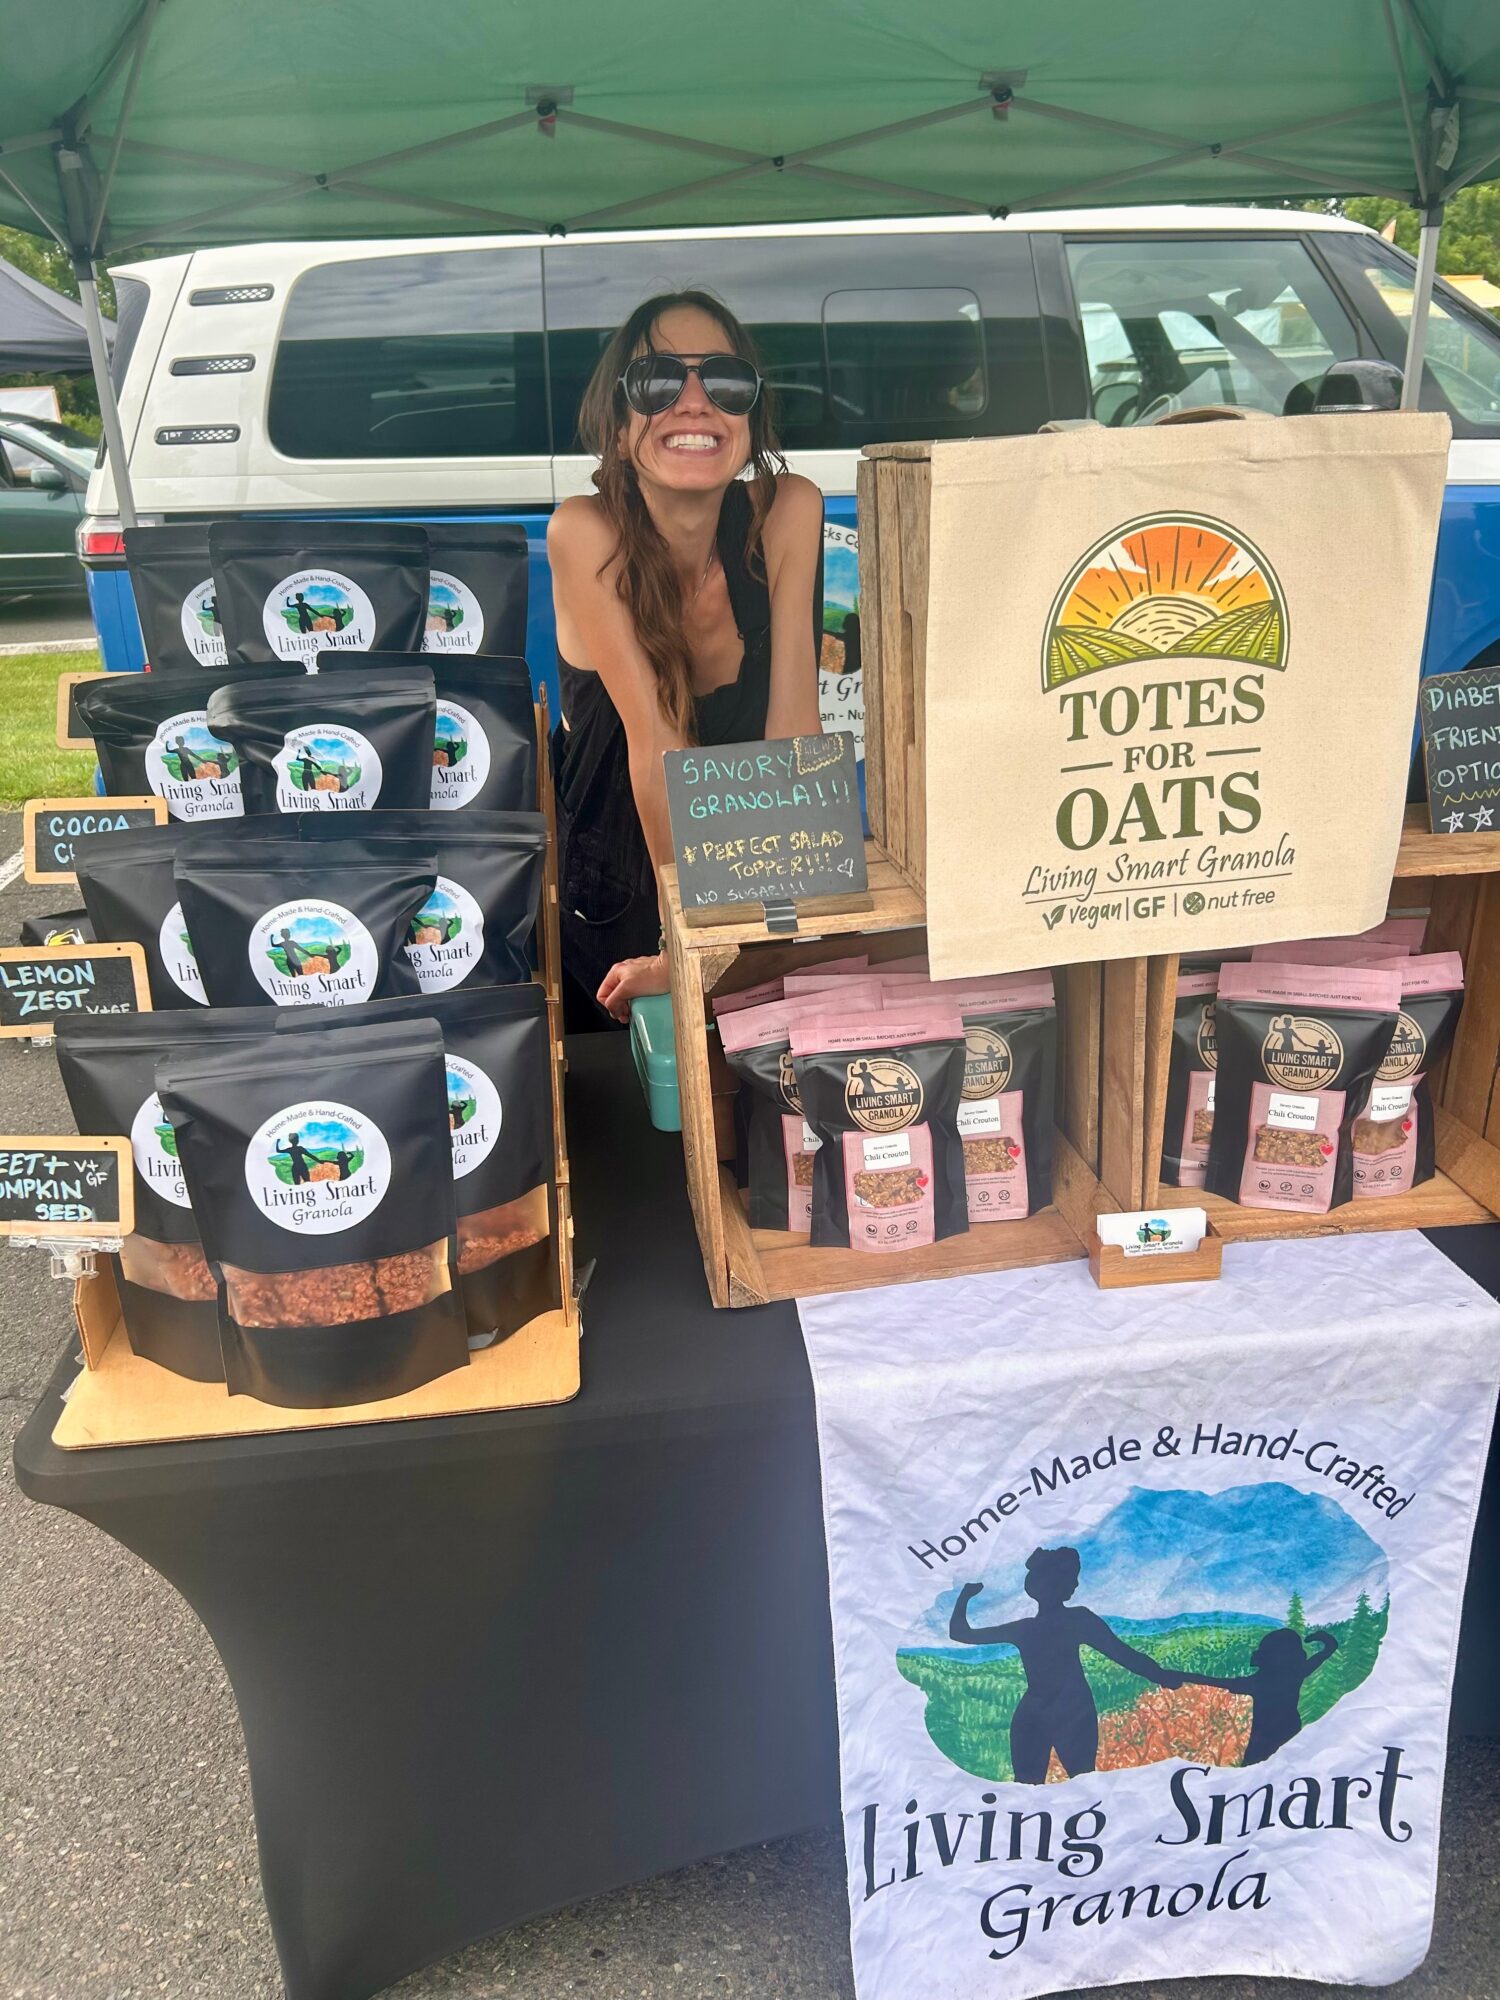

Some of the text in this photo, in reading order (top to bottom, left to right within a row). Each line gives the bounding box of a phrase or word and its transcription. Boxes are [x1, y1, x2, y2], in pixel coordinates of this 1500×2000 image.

[194, 637, 227, 655] Livin
[278, 629, 366, 652] Living Smart
[436, 631, 474, 648] Smart
[1059, 673, 1266, 742] TOTES
[682, 750, 794, 785] SAVORY
[1122, 741, 1196, 774] FOR
[437, 765, 478, 784] Smart
[160, 779, 242, 801] Living Smar
[281, 789, 367, 812] Living Smart
[689, 779, 851, 819] GRANOLA!!!
[185, 797, 234, 817] Granola
[1055, 770, 1263, 851] OATS
[50, 814, 130, 837] COCOA
[702, 829, 844, 861] PERFECT SALAD
[1021, 832, 1296, 902] Living Smart Granola
[695, 890, 718, 906] NO
[261, 907, 296, 933] Home-Made
[304, 906, 347, 925] Hand-Crafted
[1069, 889, 1276, 930] vegan GF nut free
[429, 941, 473, 962] Smart
[0, 960, 96, 989] LEMON
[177, 962, 200, 981] Liv
[416, 963, 454, 979] anola
[268, 968, 366, 999] Living Smart
[12, 988, 91, 1017] ZEST
[1271, 1051, 1334, 1067] LIVING SMART
[1390, 1041, 1417, 1055] SMART
[975, 1059, 1004, 1074] SMART
[1282, 1066, 1320, 1079] GRANOLA
[855, 1091, 914, 1109] LIVING SMART
[1371, 1104, 1387, 1112] Chili
[266, 1111, 307, 1138] Home-Made
[315, 1109, 363, 1130] Hand-Crafted
[868, 1108, 905, 1121] GRANOLA
[972, 1116, 999, 1125] Crouton
[1268, 1109, 1315, 1121] Chili Crouton
[452, 1124, 489, 1148] mart
[147, 1156, 182, 1177] Livi
[864, 1149, 909, 1162] Chili Crouton
[86, 1171, 109, 1187] GF
[262, 1175, 377, 1207] Living Smart
[35, 1203, 93, 1222] SEED
[292, 1200, 353, 1226] Granola
[907, 1422, 1416, 1570] Home-Made & Hand-Crafted
[862, 1745, 1413, 1902] Living Smart
[979, 1849, 1271, 1961] Granola
